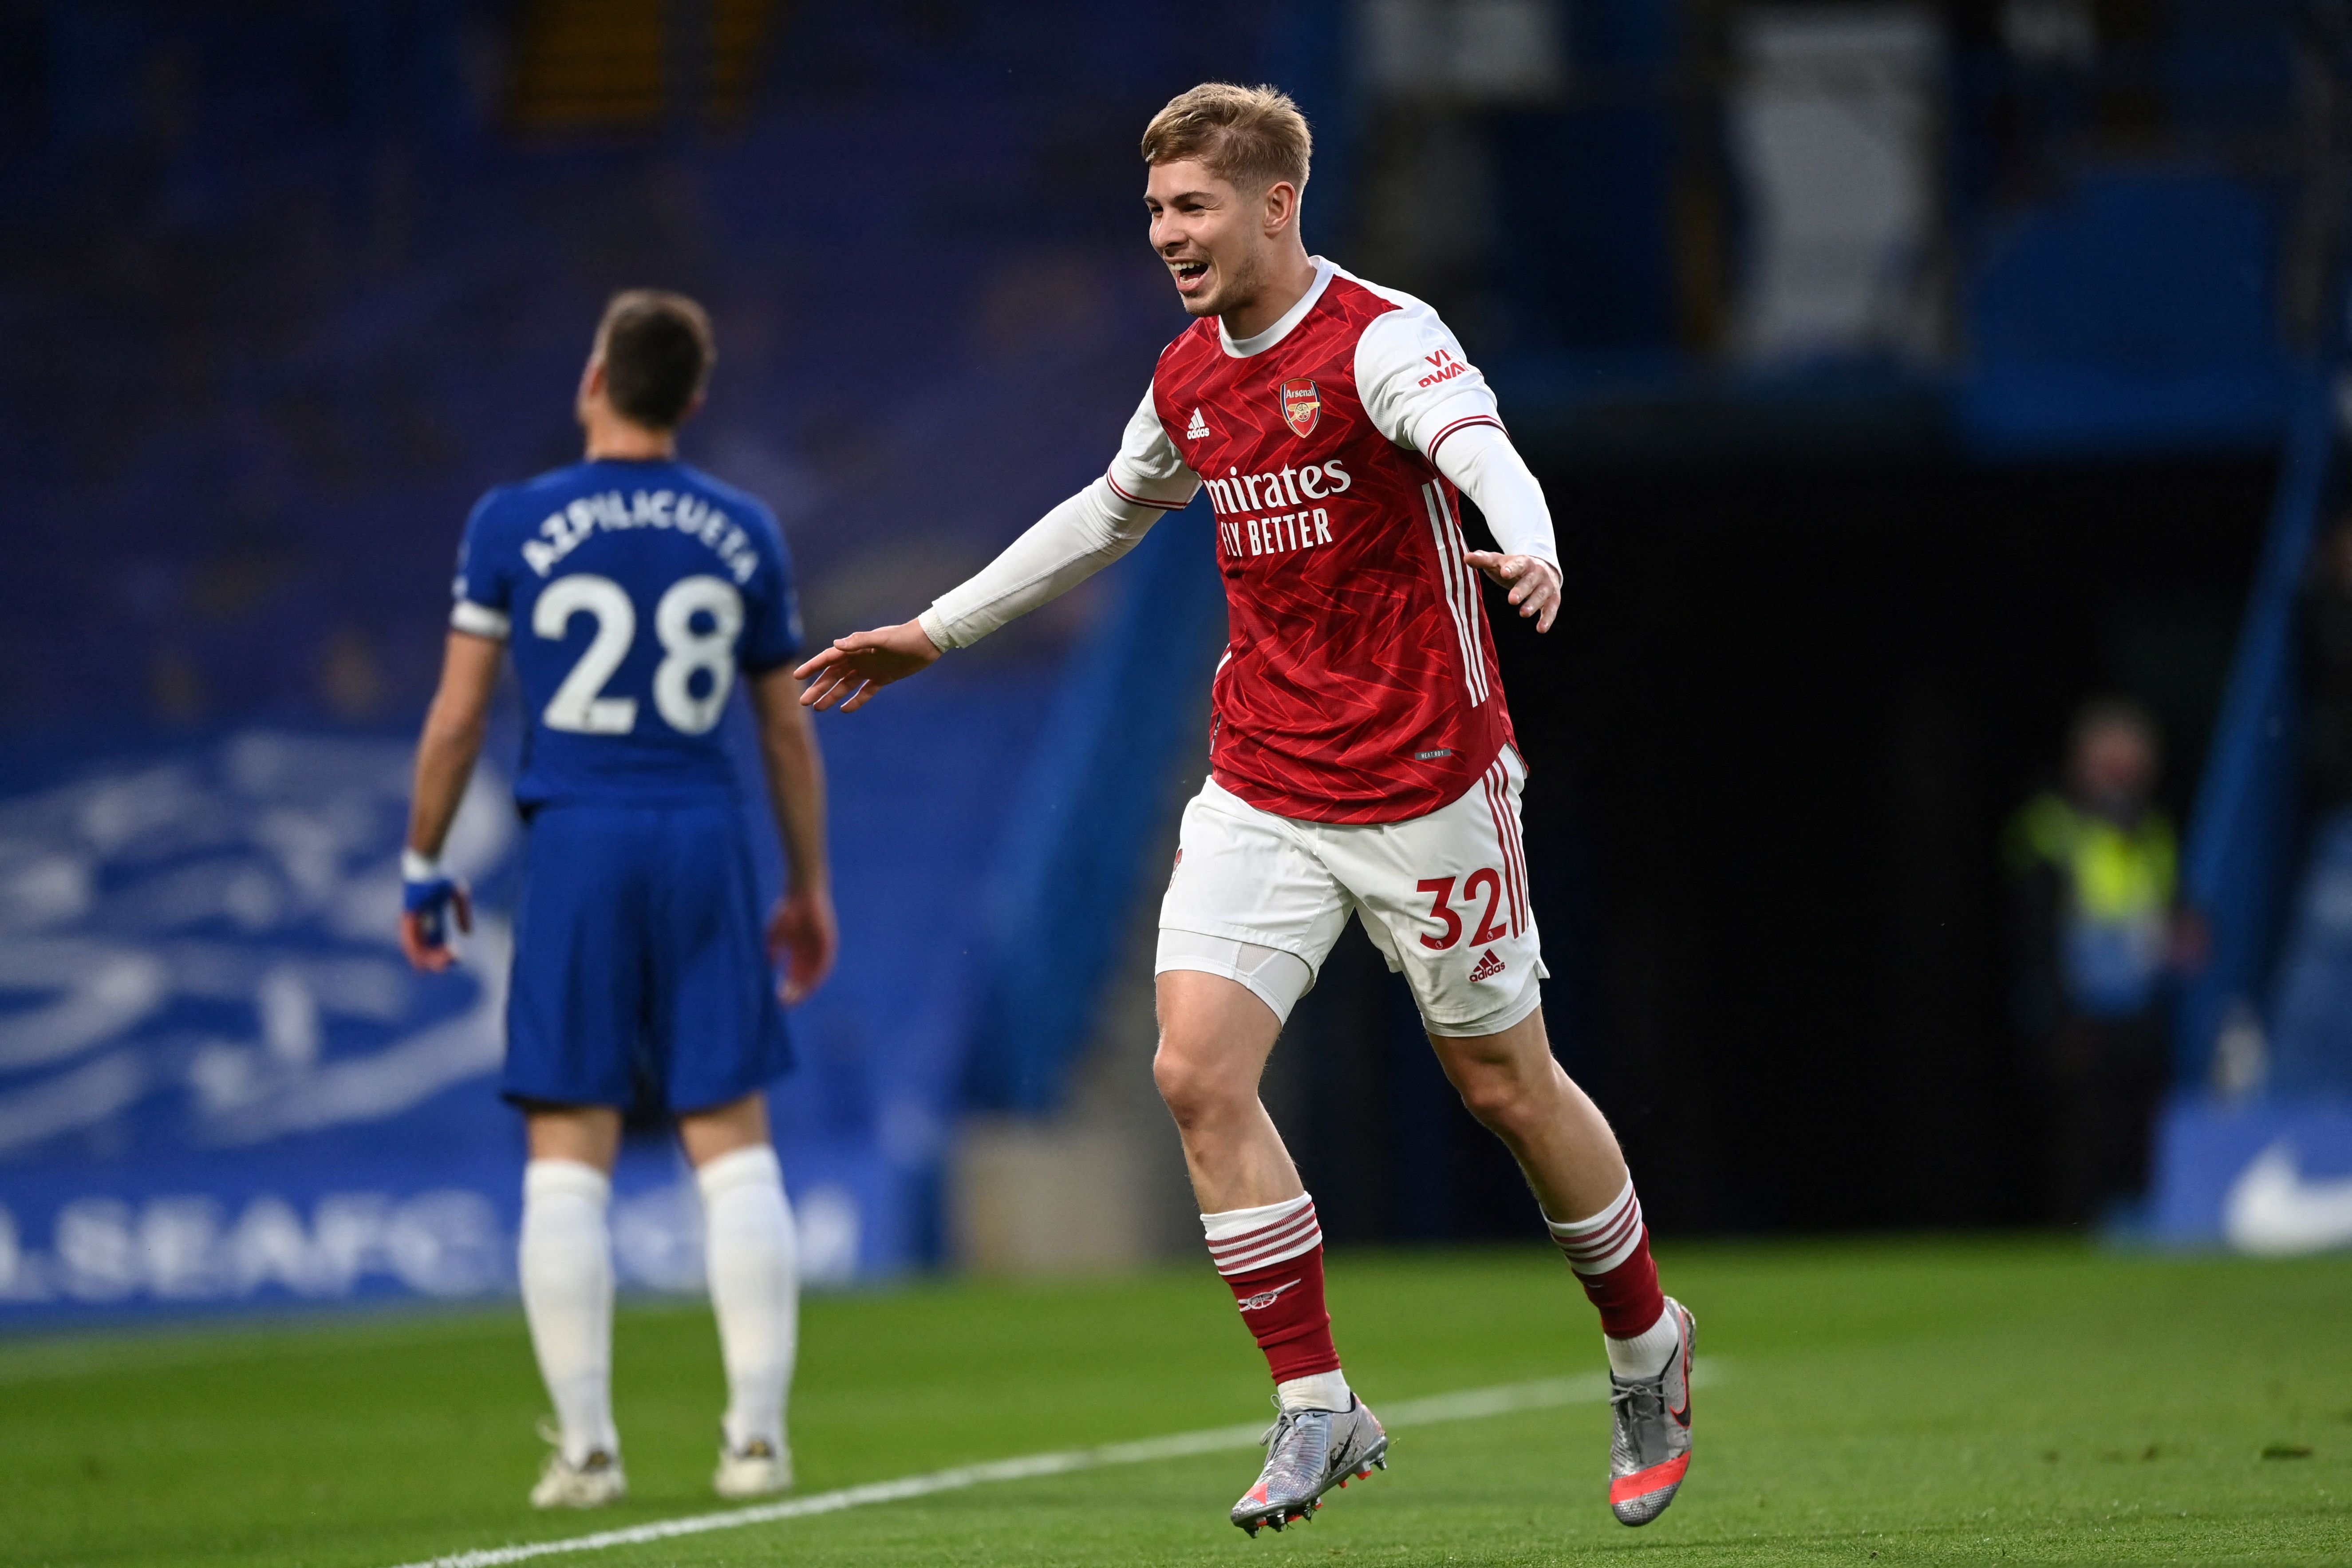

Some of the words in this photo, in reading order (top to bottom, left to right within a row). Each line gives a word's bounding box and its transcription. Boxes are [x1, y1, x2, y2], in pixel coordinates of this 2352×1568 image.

[1425, 349, 1453, 367] VI
[1285, 387, 1316, 399] Arsenal
[1187, 427, 1210, 440] adidas
[1203, 459, 1351, 514] mirates
[522, 490, 759, 583] AZPILICUETA
[1220, 521, 1243, 557] FLY
[1247, 508, 1333, 556] BETTER
[533, 574, 744, 735] 28
[1421, 750, 1444, 759] HEAT.RDY
[1416, 867, 1507, 950] 32
[1469, 961, 1506, 982] adidas
